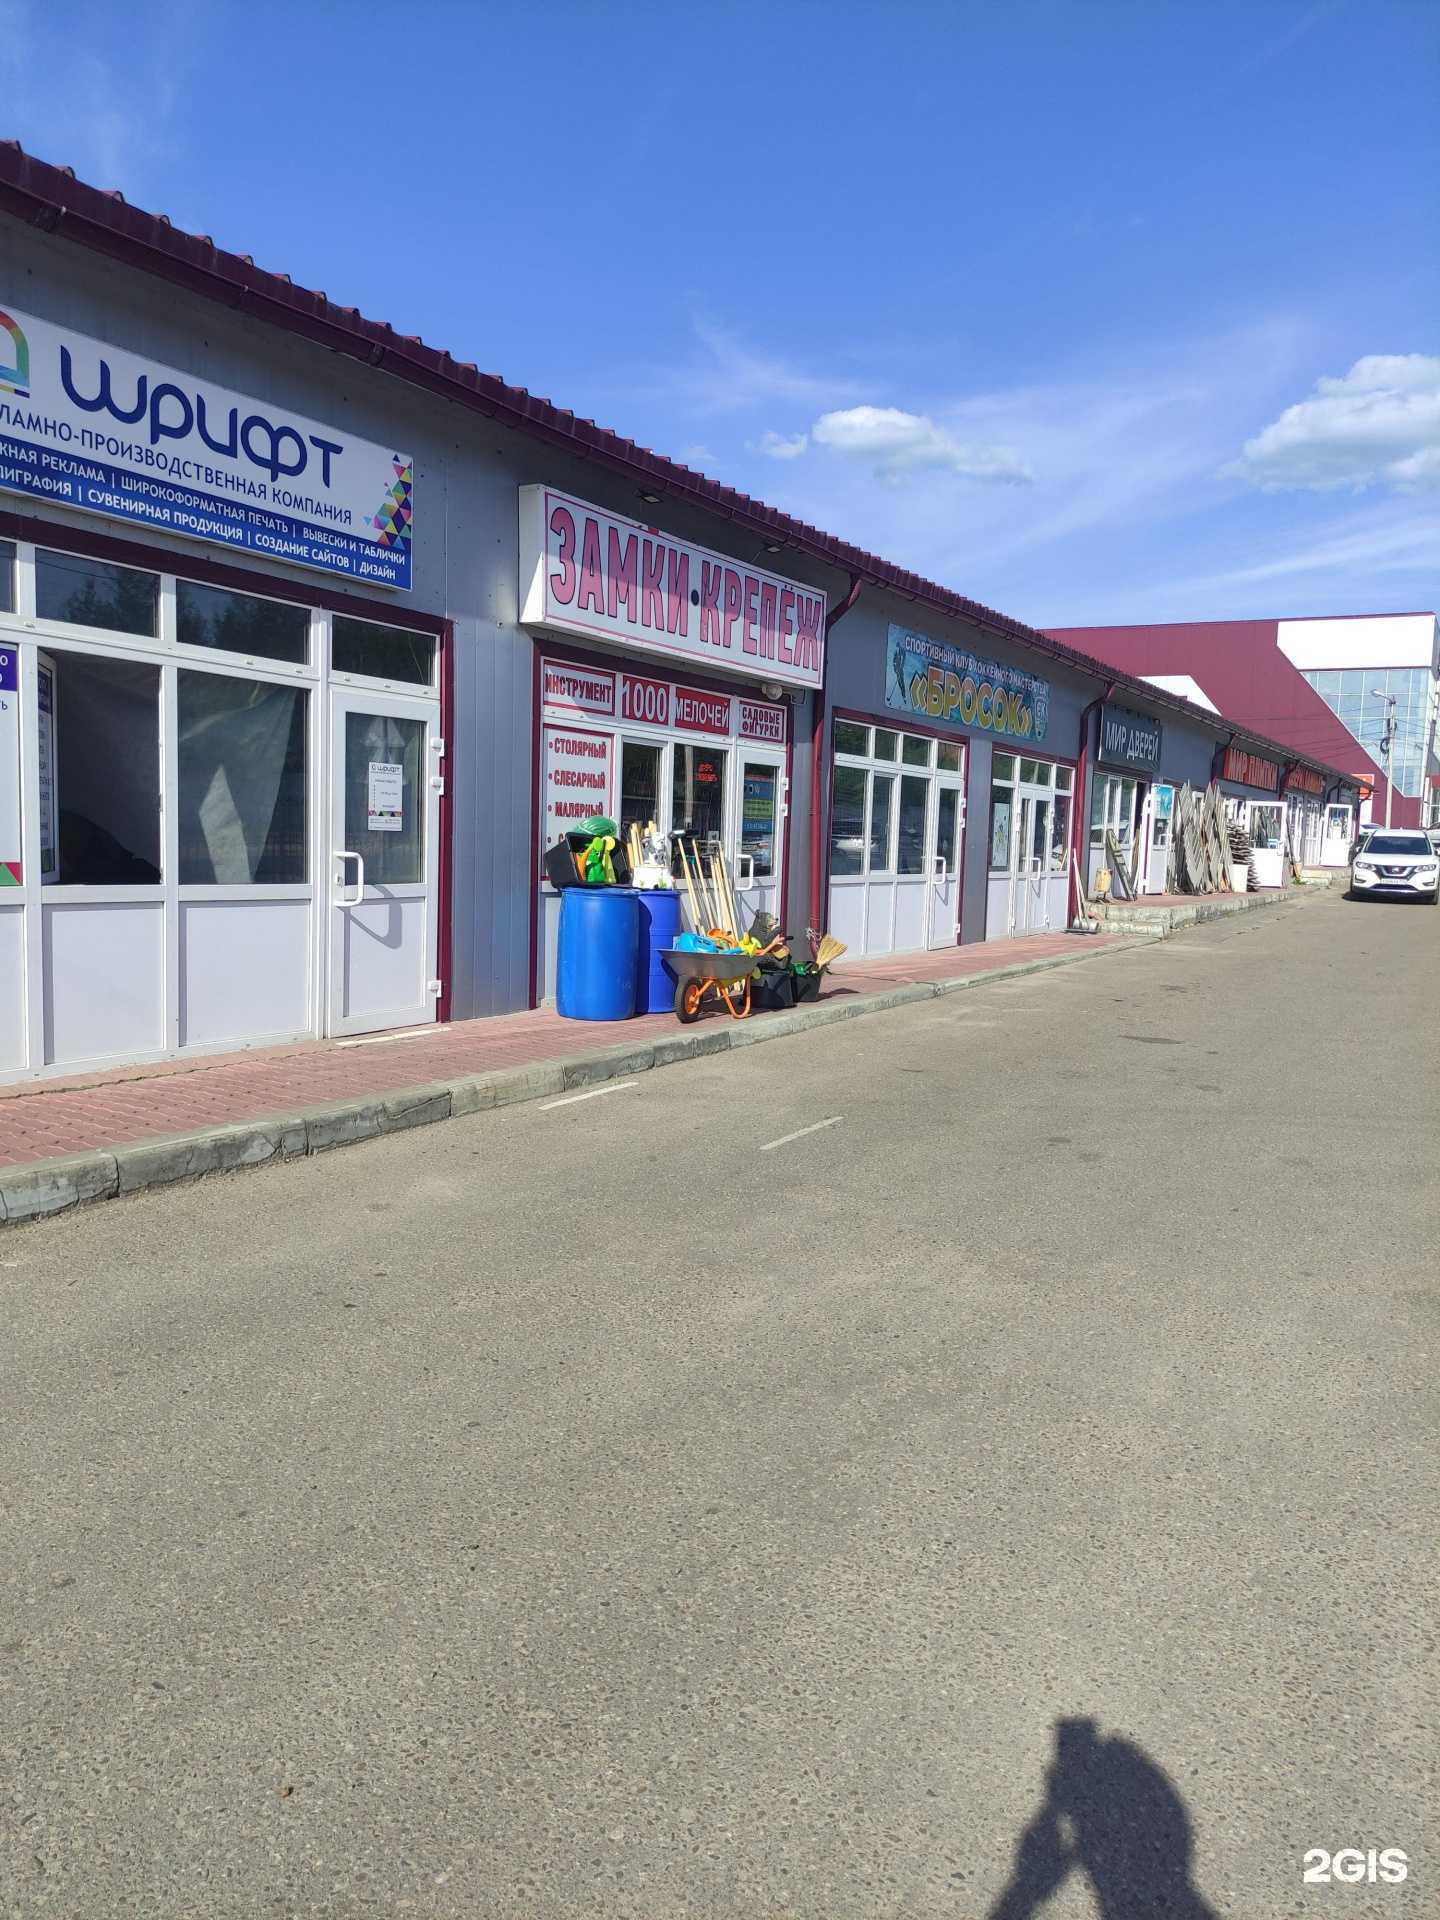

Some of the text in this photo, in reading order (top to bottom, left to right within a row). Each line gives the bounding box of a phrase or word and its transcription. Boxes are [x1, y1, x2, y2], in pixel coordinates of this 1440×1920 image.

[41, 453, 106, 484] РЕКЛАМА
[121, 475, 246, 522] ШИРОКОФОРМАТНАЯ
[248, 510, 289, 534] ПЕЧАТЬ
[303, 526, 347, 551] ВЫВЕСКИ
[350, 539, 357, 552] И
[358, 541, 406, 566] ТАБЛИЧКИ
[271, 486, 353, 526] КОМПАНИЯ
[88, 488, 171, 522] СУВЕНИРНАЯ
[173, 511, 243, 543] ПРОДУКЦИЯ
[255, 532, 309, 559] СОЗДАНИЕ
[311, 547, 350, 569] САЙТОВ
[359, 560, 396, 581] ДИЗАЙН
[549, 506, 690, 638] ЗАМКИ
[905, 635, 955, 665] СПОРТИВНЫЙ
[955, 654, 974, 672] КЛУБ
[545, 673, 612, 704] ИНСТРУМЕНТ
[622, 680, 666, 722] 1000
[674, 696, 730, 728] МЕЛОЧЕЙ
[742, 706, 780, 725] САДОВЫЕ
[742, 722, 780, 738] ФИГУРКИ
[1105, 720, 1159, 761] МИР ДВЕРЕЙ
[554, 737, 607, 759] СТОЛЯРНЫЙ
[554, 769, 606, 789] СЛЕСАРНЫЙ
[555, 801, 604, 818] МАЛЯРНЫЙ
